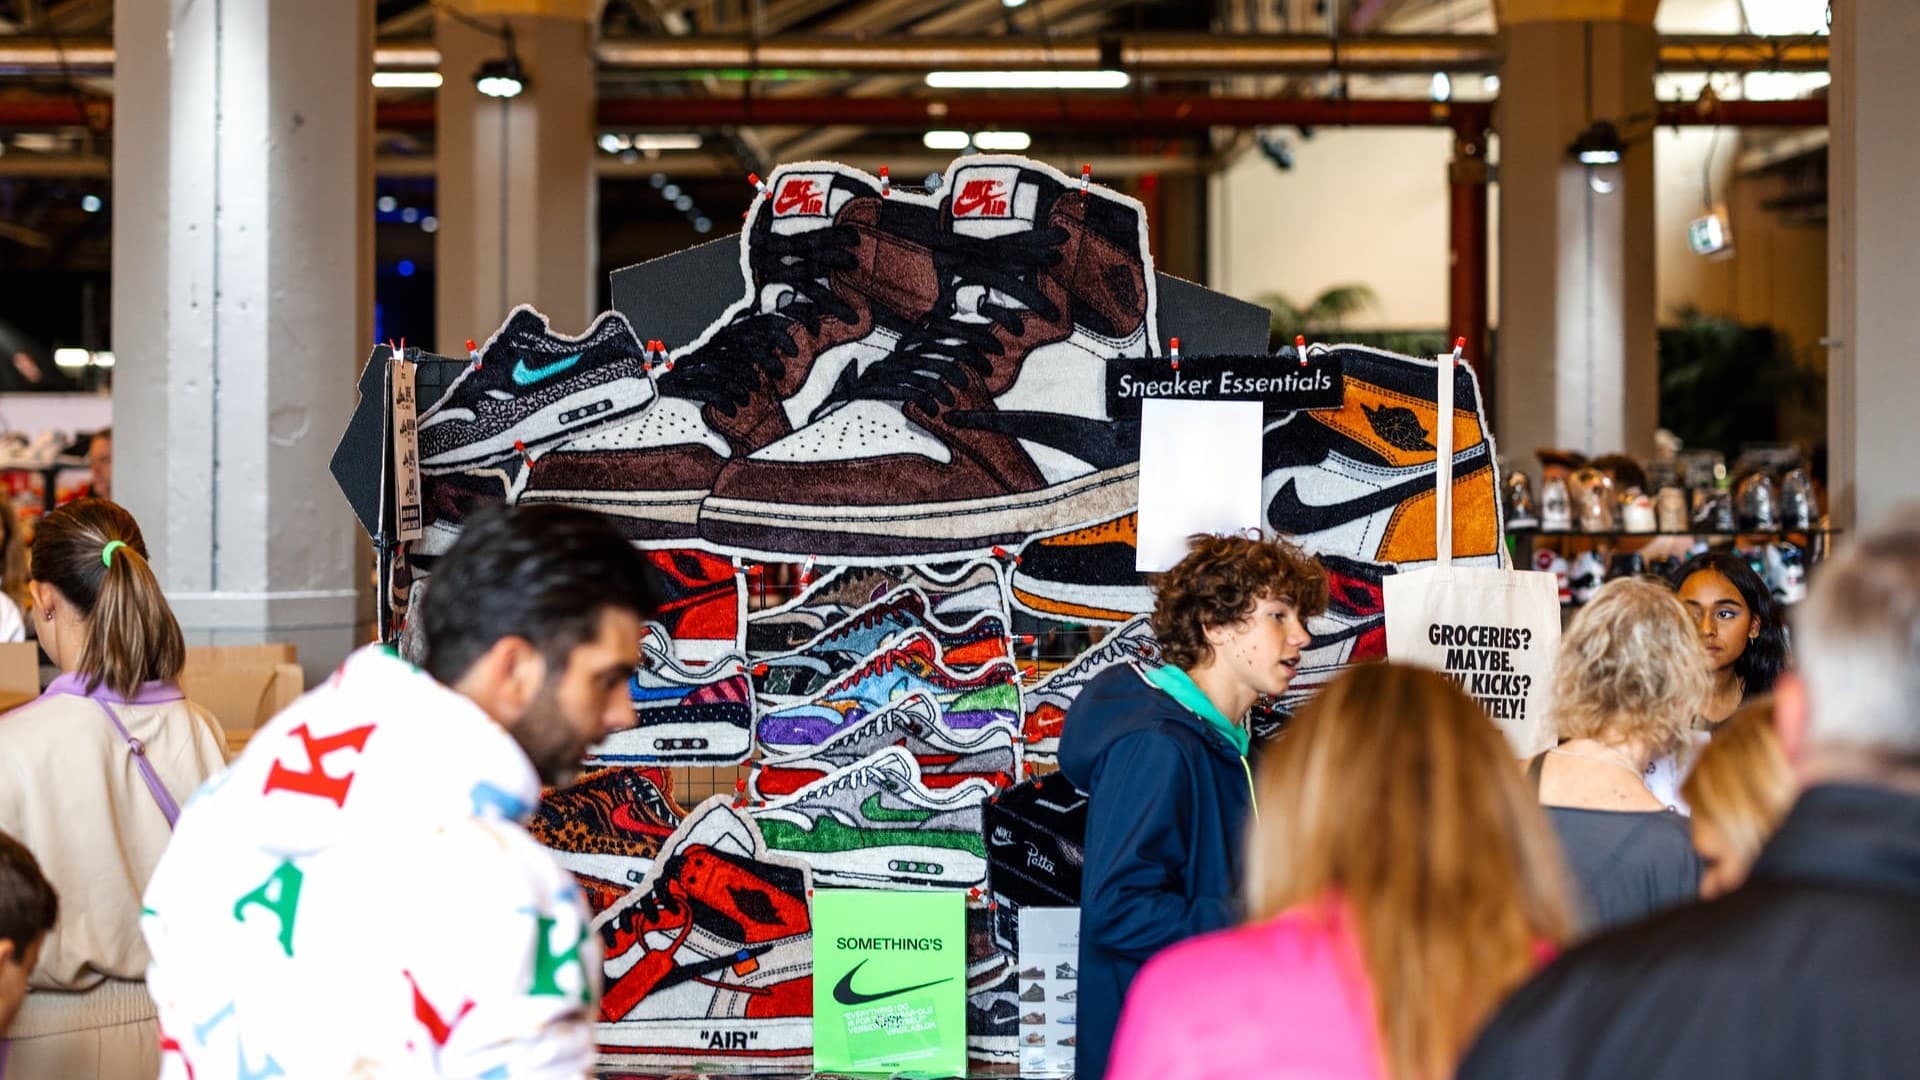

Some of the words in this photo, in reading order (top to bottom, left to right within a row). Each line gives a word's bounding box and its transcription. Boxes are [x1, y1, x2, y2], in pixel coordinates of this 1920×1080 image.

[1118, 370, 1212, 398] Sneaker
[1219, 369, 1332, 395] Essentials
[1428, 623, 1532, 650] GROCERIES?
[1445, 648, 1514, 672] MAYBE.
[1471, 672, 1532, 697] KICKS?
[836, 937, 943, 951] SOMETHING'S
[700, 1030, 759, 1049] "AIR"
